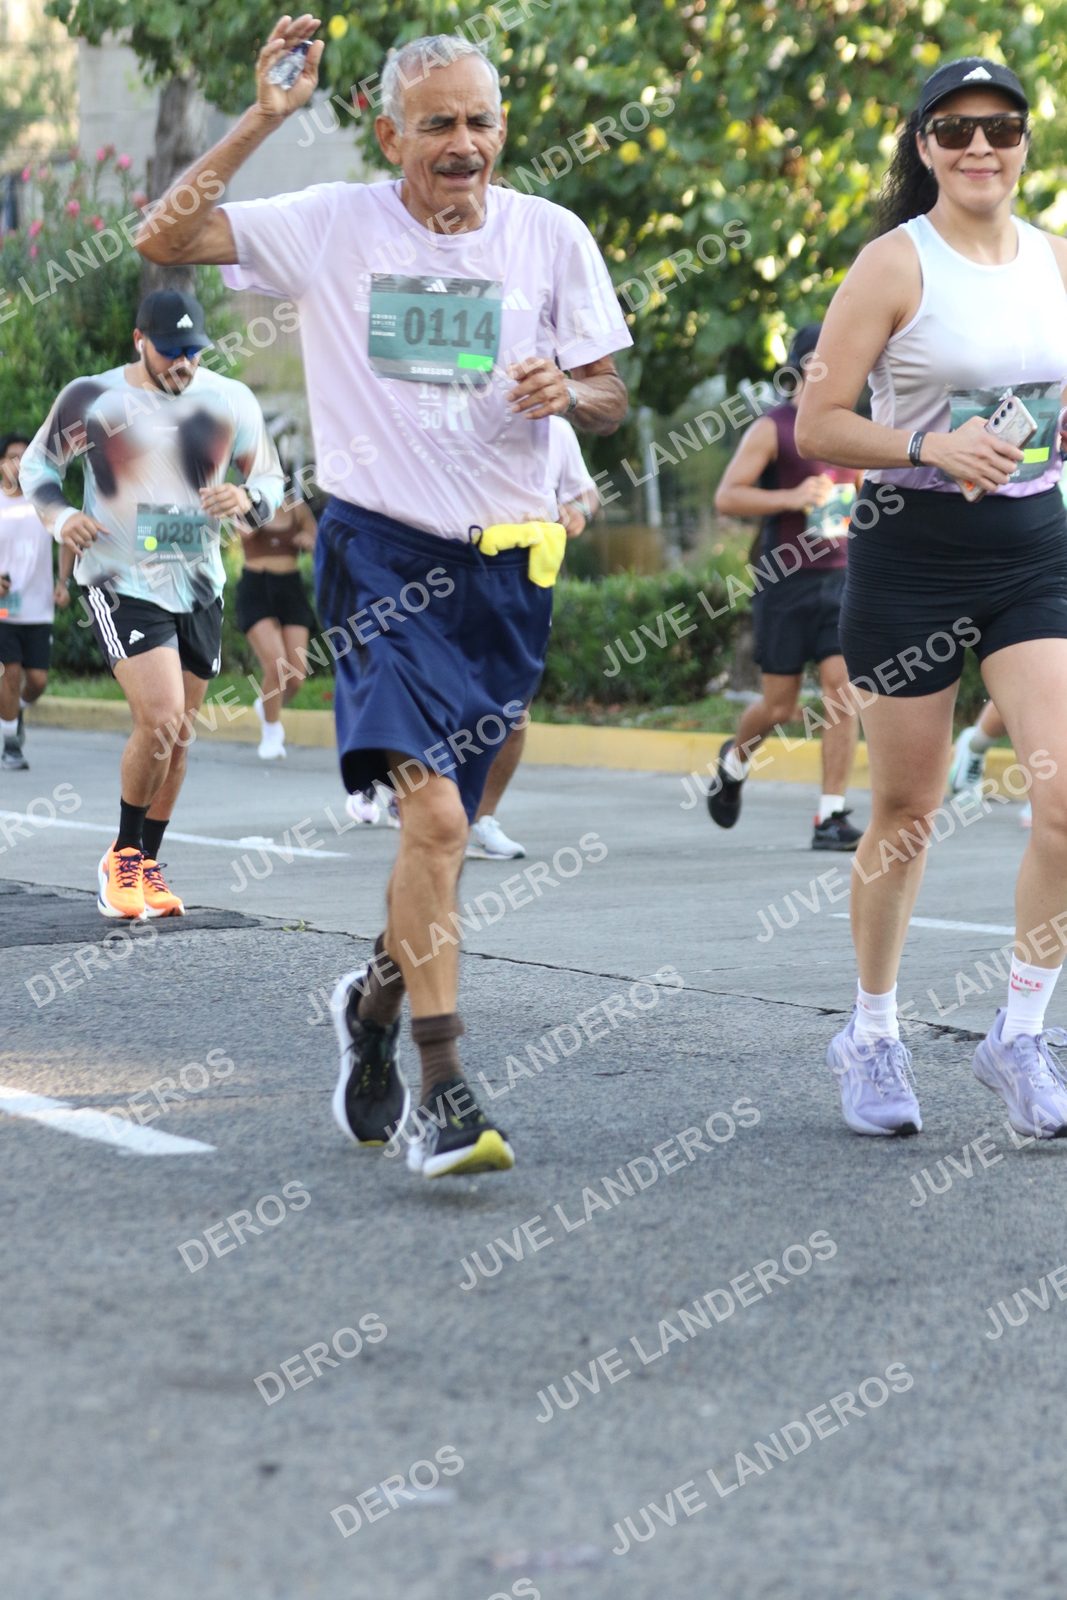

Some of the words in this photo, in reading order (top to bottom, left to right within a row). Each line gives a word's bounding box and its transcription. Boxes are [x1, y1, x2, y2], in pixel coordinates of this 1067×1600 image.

[403, 306, 496, 350] 0114
[409, 366, 454, 377] SAMSUNG
[419, 409, 442, 430] 30
[1012, 971, 1043, 989] NIKE
